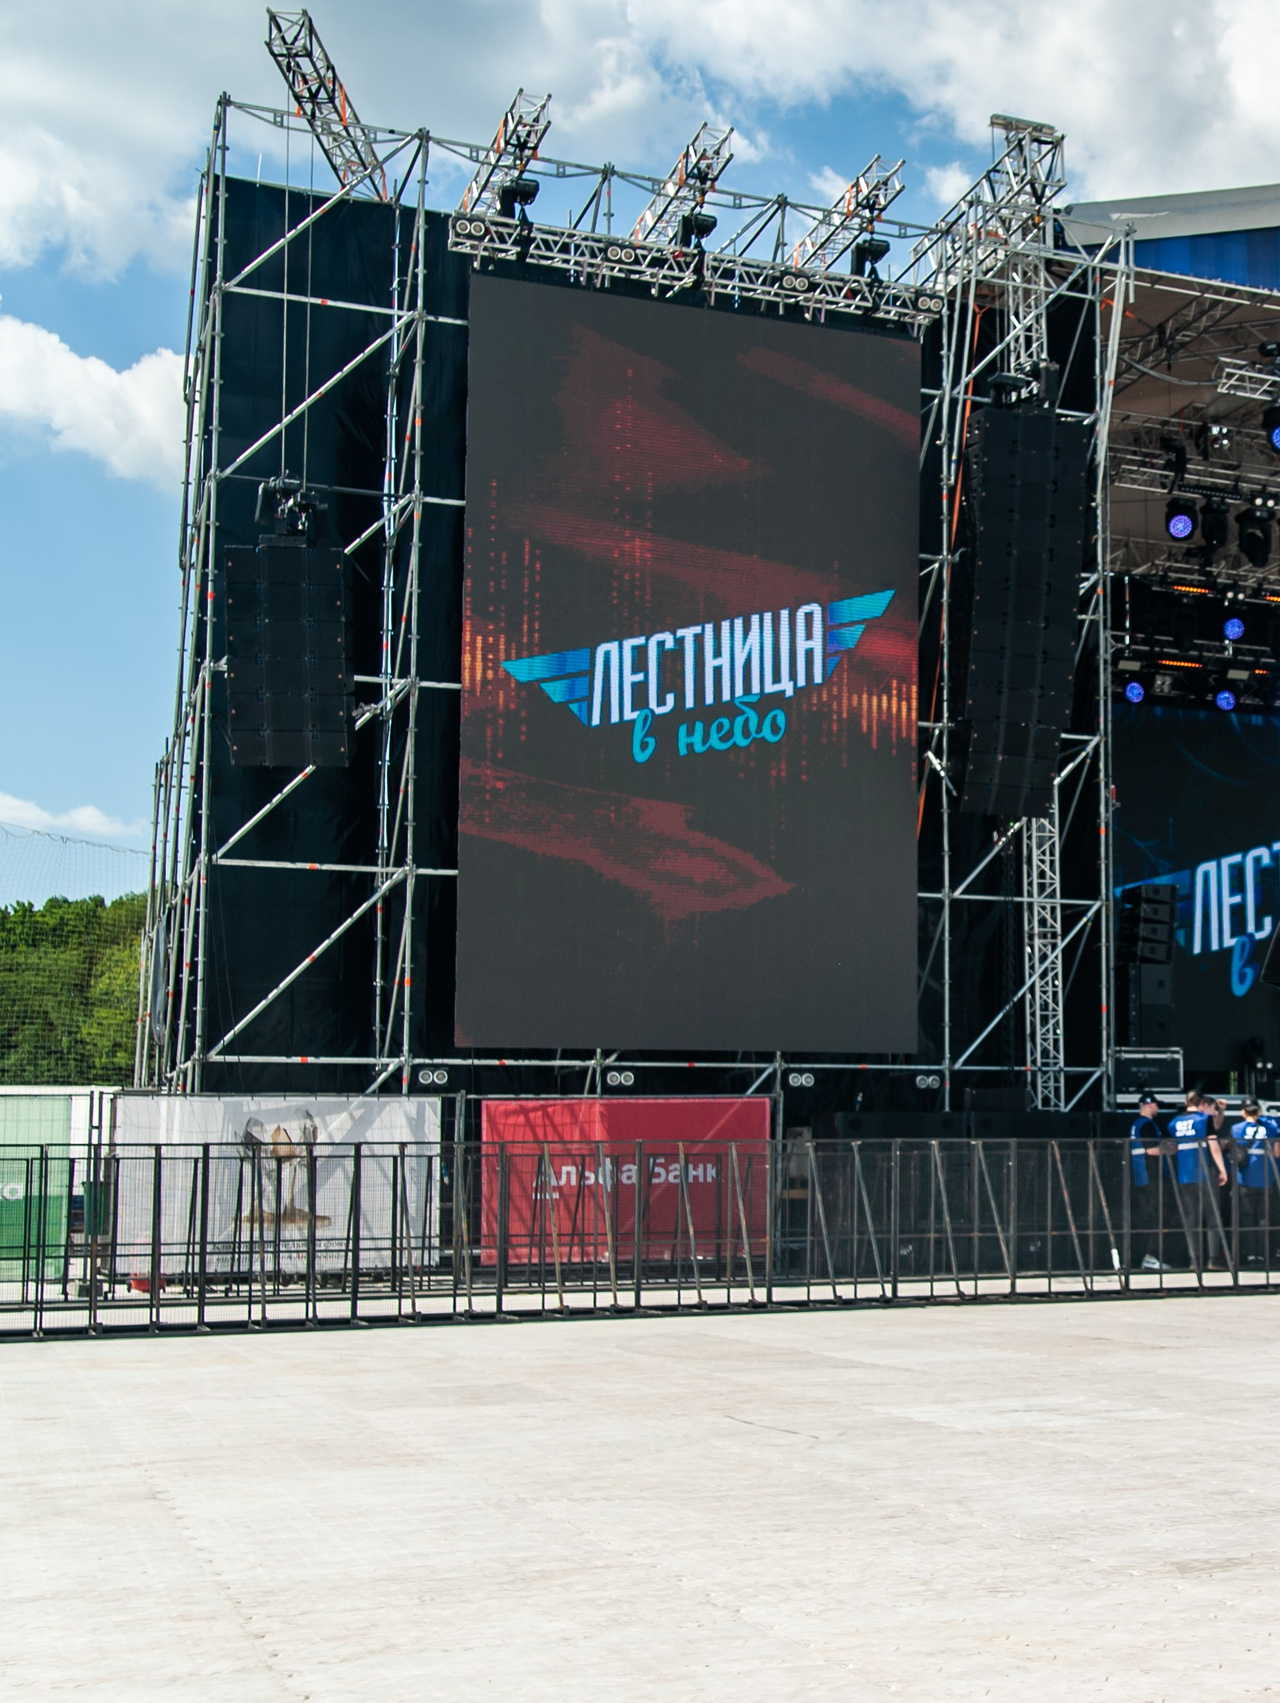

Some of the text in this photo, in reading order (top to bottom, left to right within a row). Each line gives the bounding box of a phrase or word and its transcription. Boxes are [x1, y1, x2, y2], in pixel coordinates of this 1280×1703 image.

[592, 603, 824, 728] ЛЕСТНИЦА
[632, 693, 786, 763] в небо
